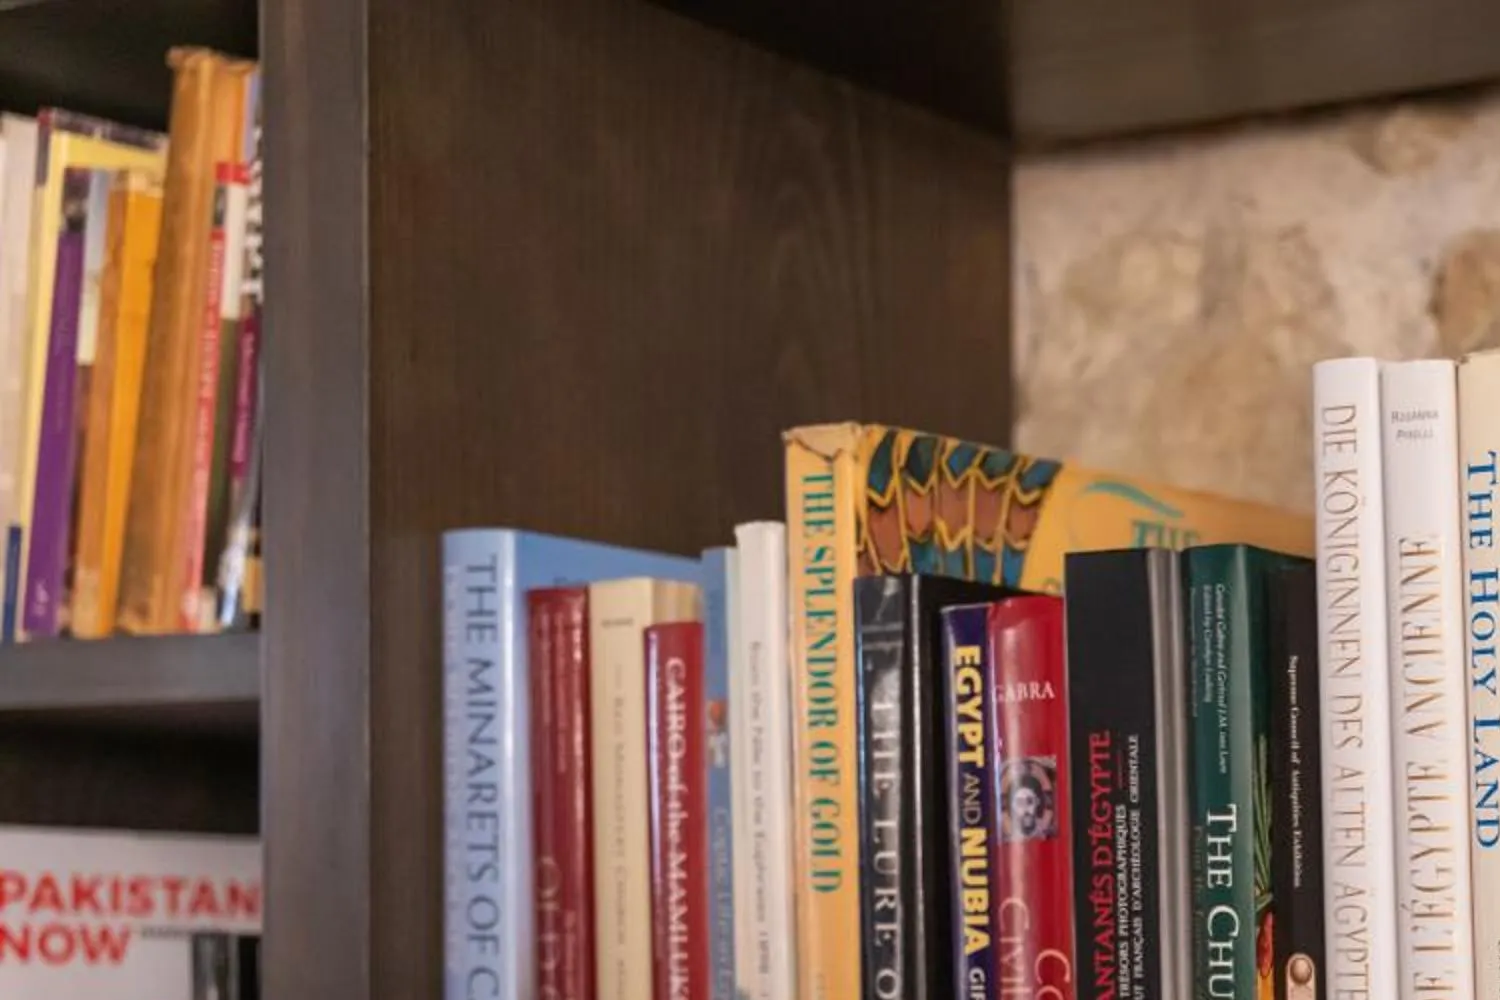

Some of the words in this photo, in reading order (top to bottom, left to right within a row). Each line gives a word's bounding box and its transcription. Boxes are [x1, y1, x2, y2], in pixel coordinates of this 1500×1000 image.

[1320, 403, 1358, 457] DIE
[801, 471, 837, 539] THE
[1466, 451, 1499, 549] THE
[464, 555, 499, 646] THE
[1321, 467, 1368, 680] KÖNIGINNEN
[803, 547, 840, 730] SPLENDOR
[1397, 537, 1447, 741] ANCIENNE
[665, 656, 688, 760] CAIRO
[871, 698, 900, 799] THE
[952, 644, 985, 768] EGYPT
[1328, 693, 1365, 751] DES
[464, 658, 500, 884] MINARETS
[666, 763, 690, 791] of
[807, 741, 842, 786] OF
[962, 772, 982, 824] AND
[1087, 731, 1113, 866] D'ÉGYPTE
[667, 798, 690, 843] the
[809, 797, 843, 894] GOLD
[1206, 803, 1238, 889] THE
[1330, 763, 1369, 869] ALTEN
[1400, 760, 1460, 953] L'ÉGYPTE
[0, 868, 261, 918] PAKISTAN
[873, 818, 899, 947] LURE
[960, 827, 990, 956] NUBIA
[1115, 804, 1130, 937] PHOTOGRAPHIQUES
[465, 894, 501, 959] OF
